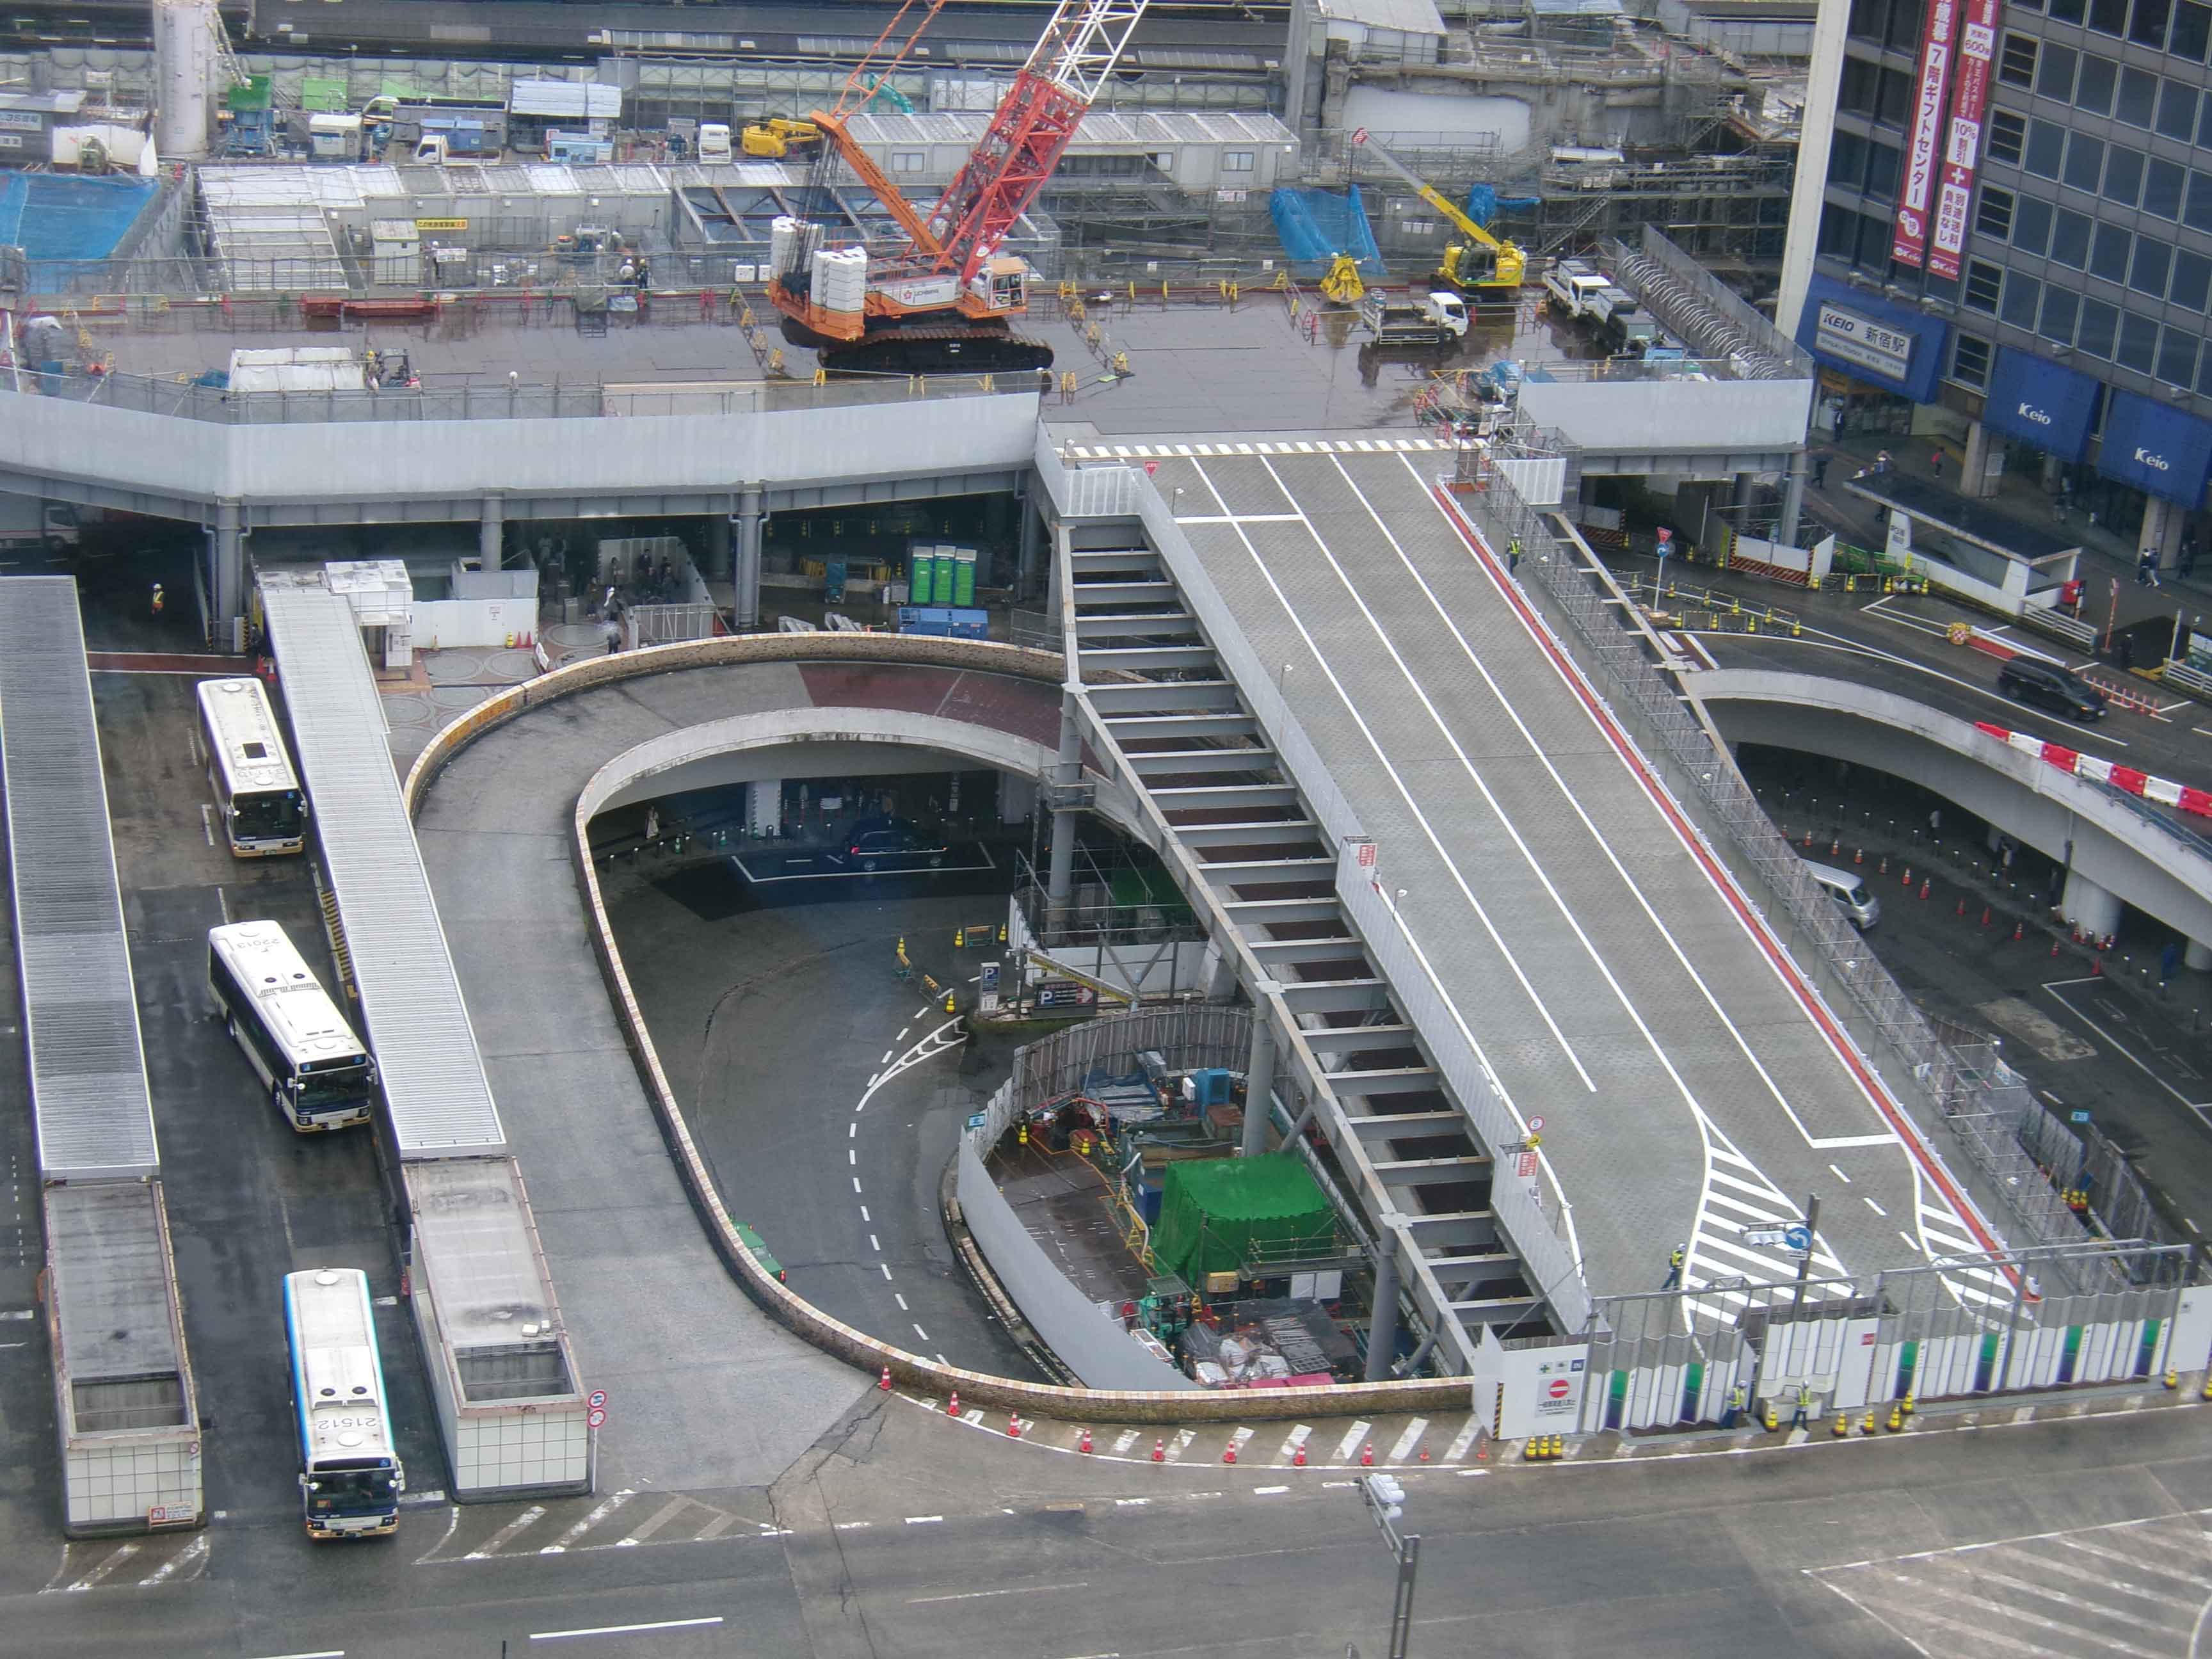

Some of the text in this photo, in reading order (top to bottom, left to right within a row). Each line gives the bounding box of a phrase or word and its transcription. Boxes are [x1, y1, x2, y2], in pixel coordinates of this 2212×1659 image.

[1823, 313, 1905, 354] KEIO 新宿駅
[2017, 402, 2051, 425] Keio
[2135, 447, 2169, 471] Keio
[984, 967, 995, 980] P
[1040, 991, 1052, 1005] P
[317, 1418, 378, 1431] 21512
